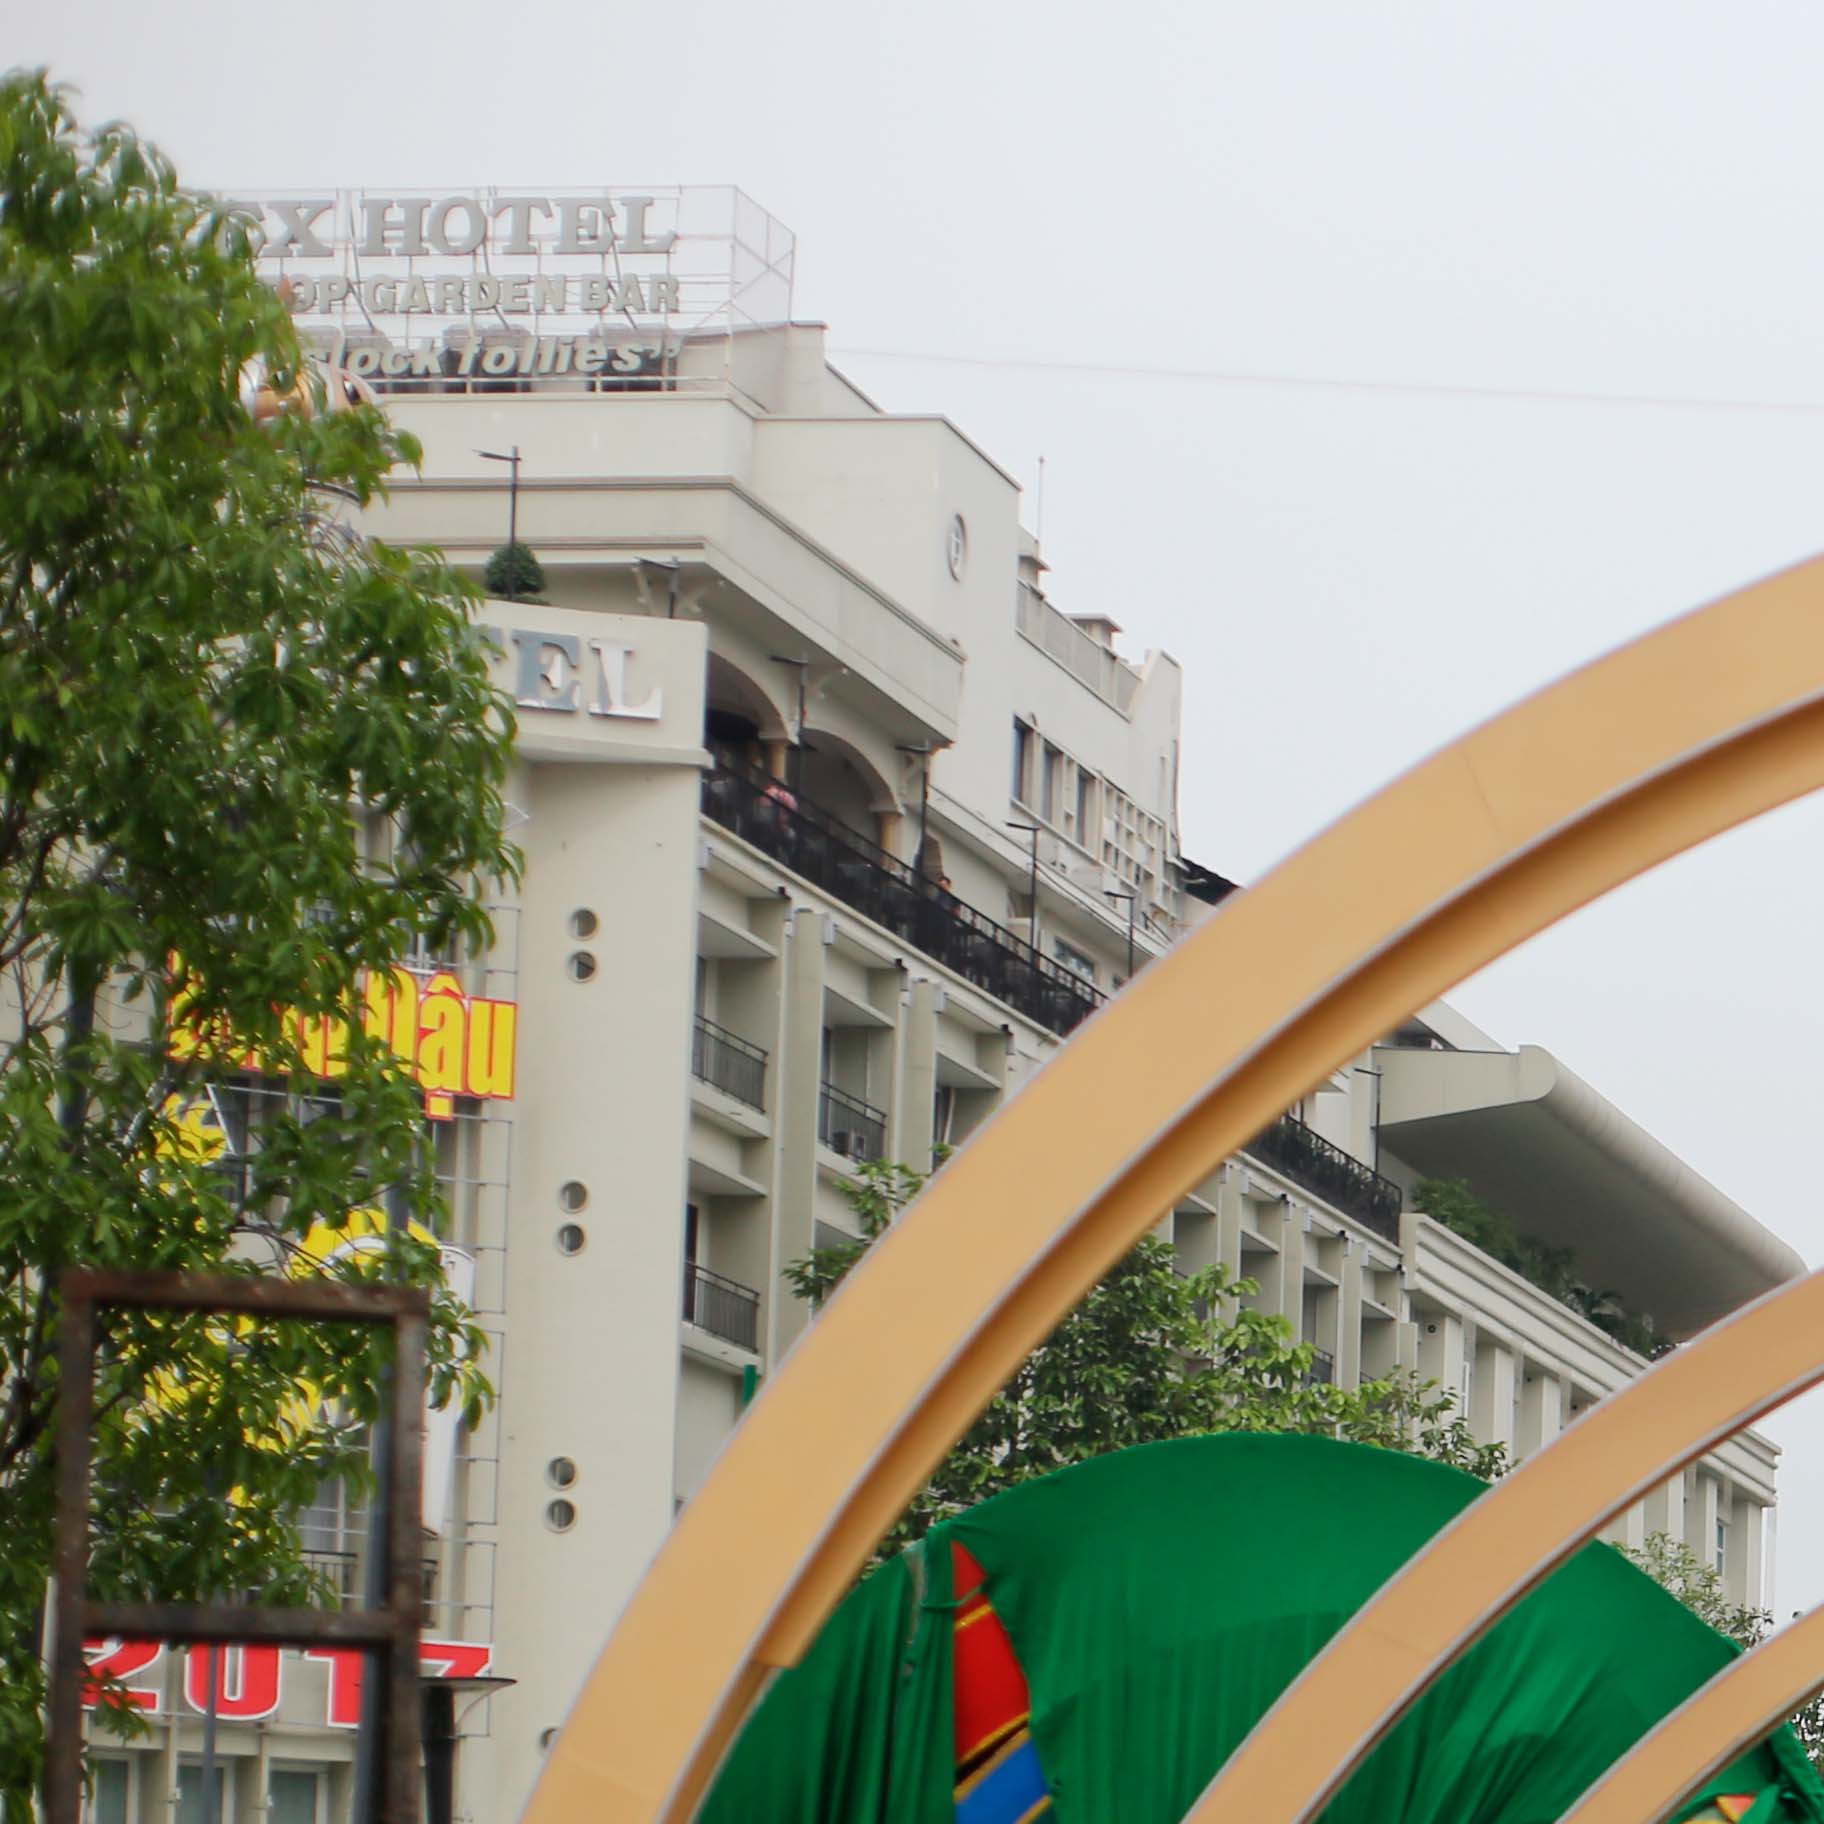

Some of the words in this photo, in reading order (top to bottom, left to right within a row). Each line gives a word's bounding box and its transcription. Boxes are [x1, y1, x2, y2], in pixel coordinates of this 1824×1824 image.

[213, 200, 335, 258] EX
[360, 197, 678, 256] HOTEL
[283, 274, 348, 315] OP
[368, 273, 566, 314] GARDEN
[585, 273, 680, 314] BAR
